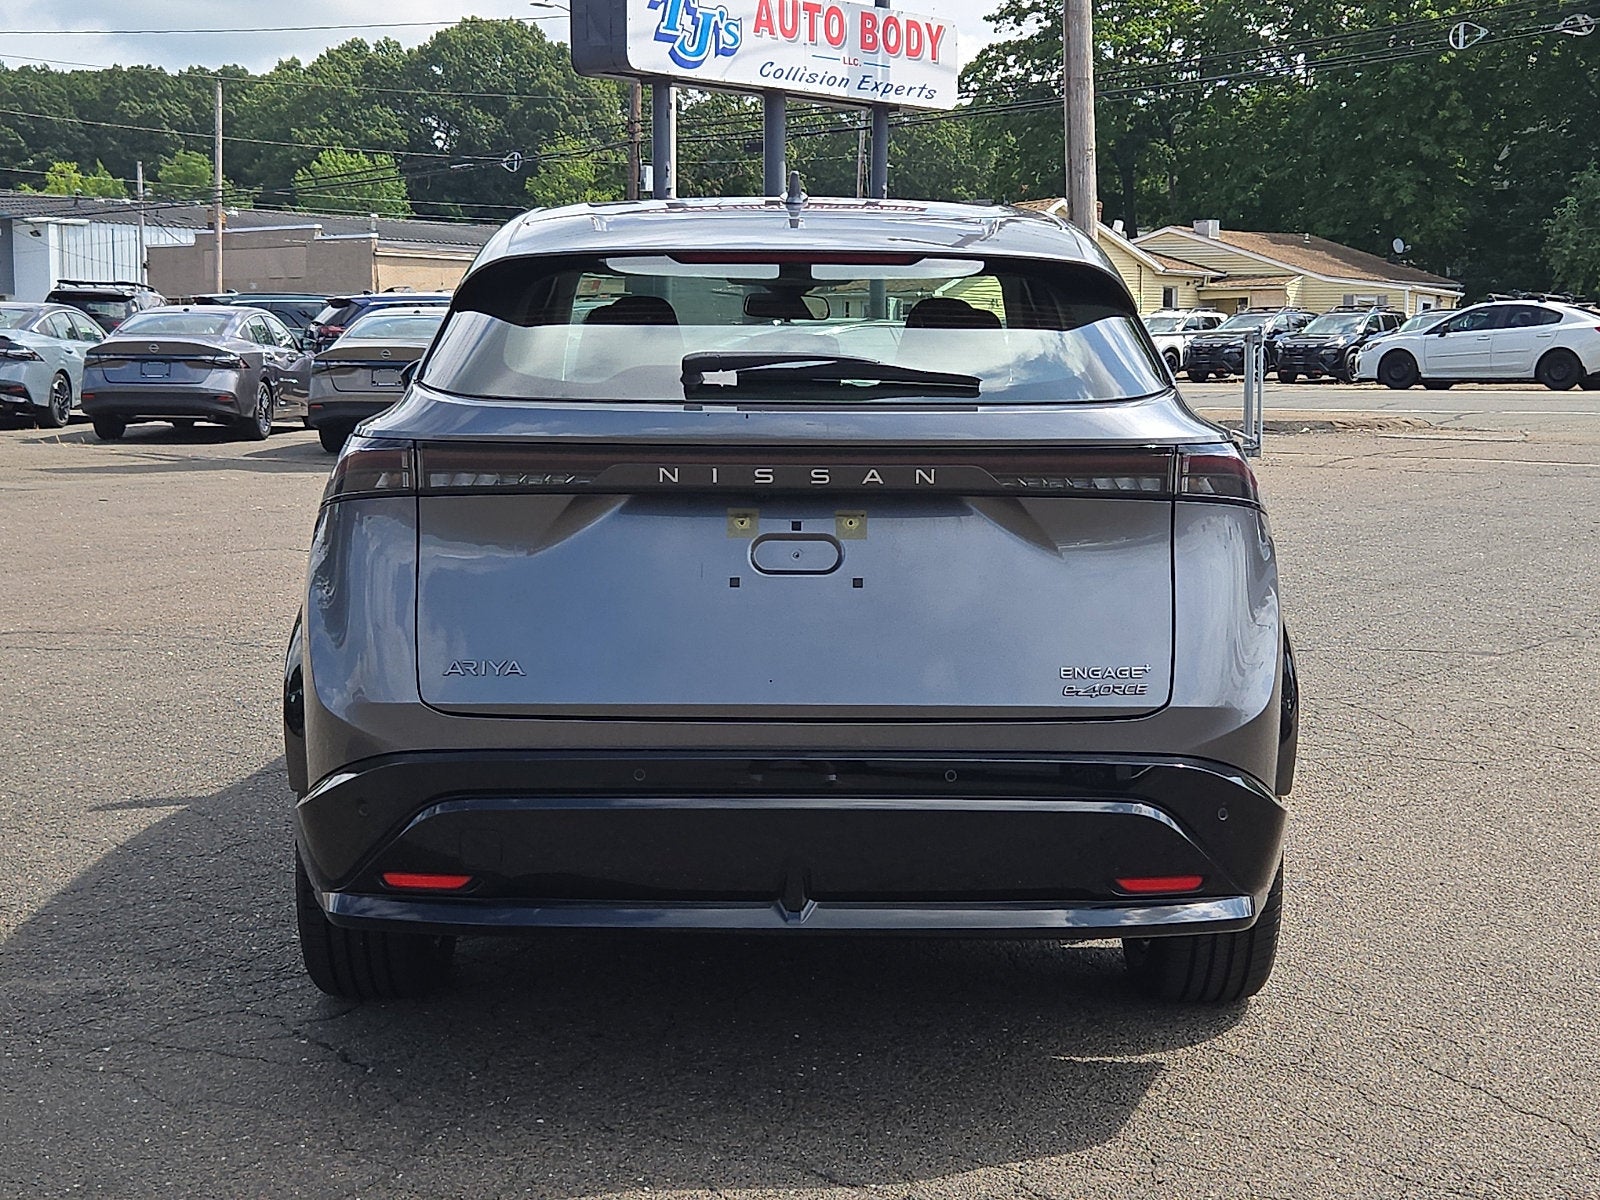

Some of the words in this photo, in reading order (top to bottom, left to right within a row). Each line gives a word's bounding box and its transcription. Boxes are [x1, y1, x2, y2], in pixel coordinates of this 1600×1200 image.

[752, 0, 847, 48] AUTO
[859, 10, 945, 63] BODY
[759, 61, 850, 88] Collision
[856, 74, 938, 101] Experts
[658, 466, 936, 485] NISSAN
[443, 659, 527, 677] ARIYA
